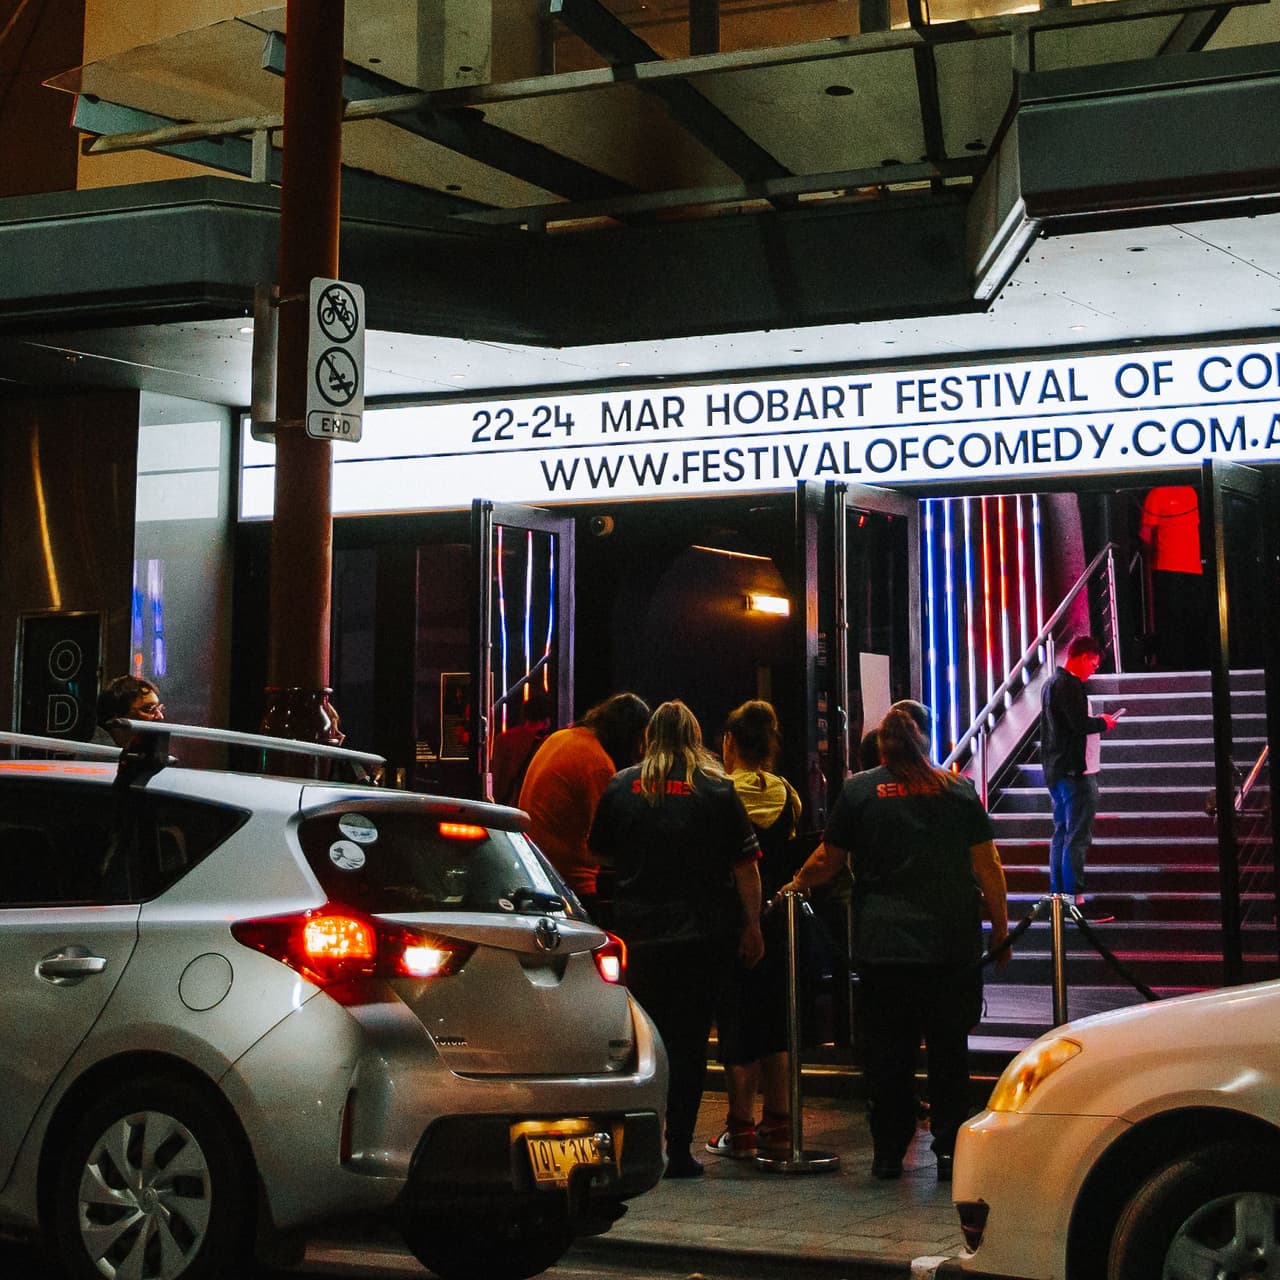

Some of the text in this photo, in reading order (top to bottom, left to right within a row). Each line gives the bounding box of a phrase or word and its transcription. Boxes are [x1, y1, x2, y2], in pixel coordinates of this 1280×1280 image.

[321, 417, 351, 434] END
[472, 406, 575, 442] 22-24
[602, 396, 685, 433] MAR
[707, 382, 873, 426] HOBART
[897, 368, 1089, 413] FESTIVAL
[1115, 361, 1174, 398] OF
